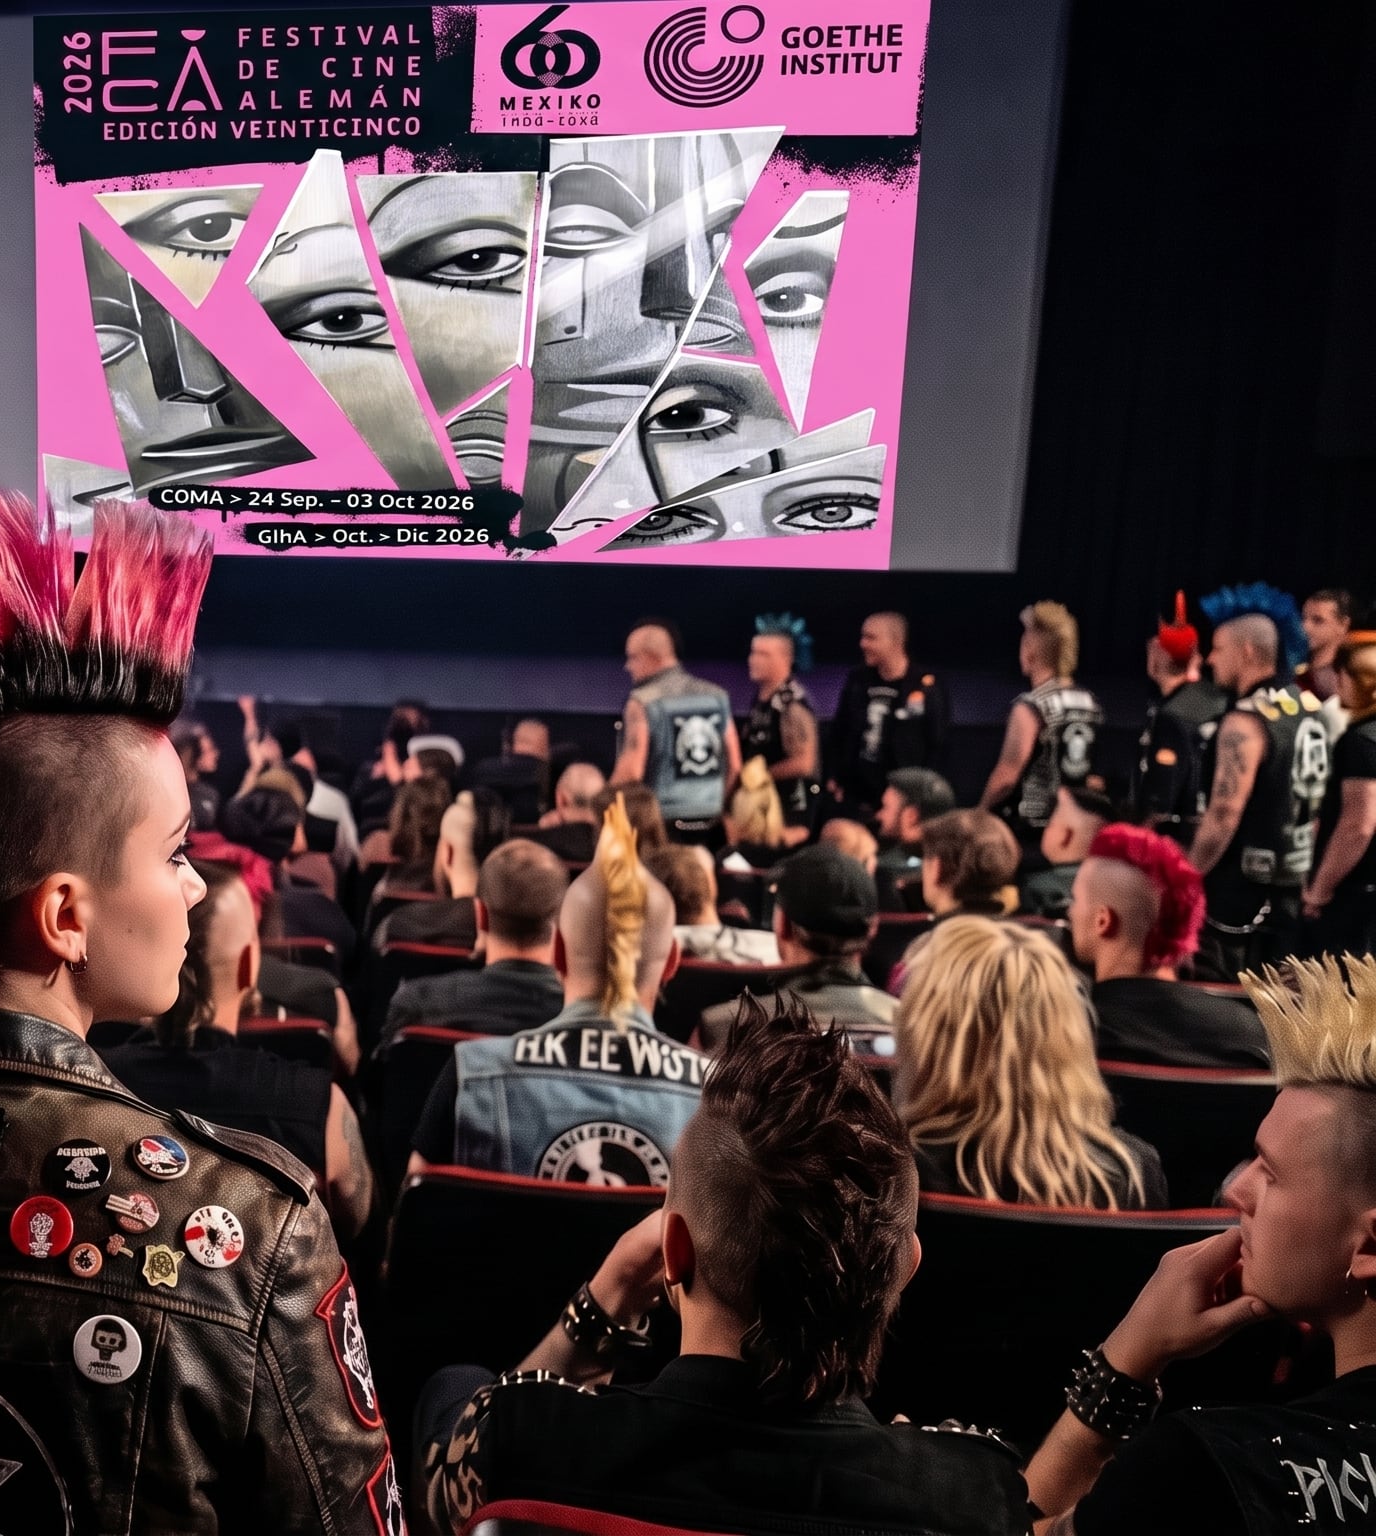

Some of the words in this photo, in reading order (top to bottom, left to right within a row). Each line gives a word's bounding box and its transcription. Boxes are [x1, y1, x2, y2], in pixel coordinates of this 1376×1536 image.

[238, 24, 421, 48] FESTIVAL
[781, 23, 904, 49] GOETHE
[62, 31, 93, 114] 2026
[238, 59, 280, 80] DE
[322, 55, 421, 78] CINE
[780, 51, 904, 76] INSTITUT
[239, 84, 421, 111] ALEMÁN
[499, 93, 601, 111] MEXIKO
[103, 115, 217, 141] EDICIÓN
[230, 116, 421, 140] VEINTICINCO
[160, 489, 224, 505] COMA
[248, 491, 275, 507] 24
[280, 492, 323, 510] Sep.
[346, 493, 373, 509] 03
[379, 493, 415, 510] Oct
[421, 495, 475, 511] 2026
[332, 528, 374, 544] Oct.
[397, 528, 429, 544] Dic
[436, 528, 490, 544] 2026
